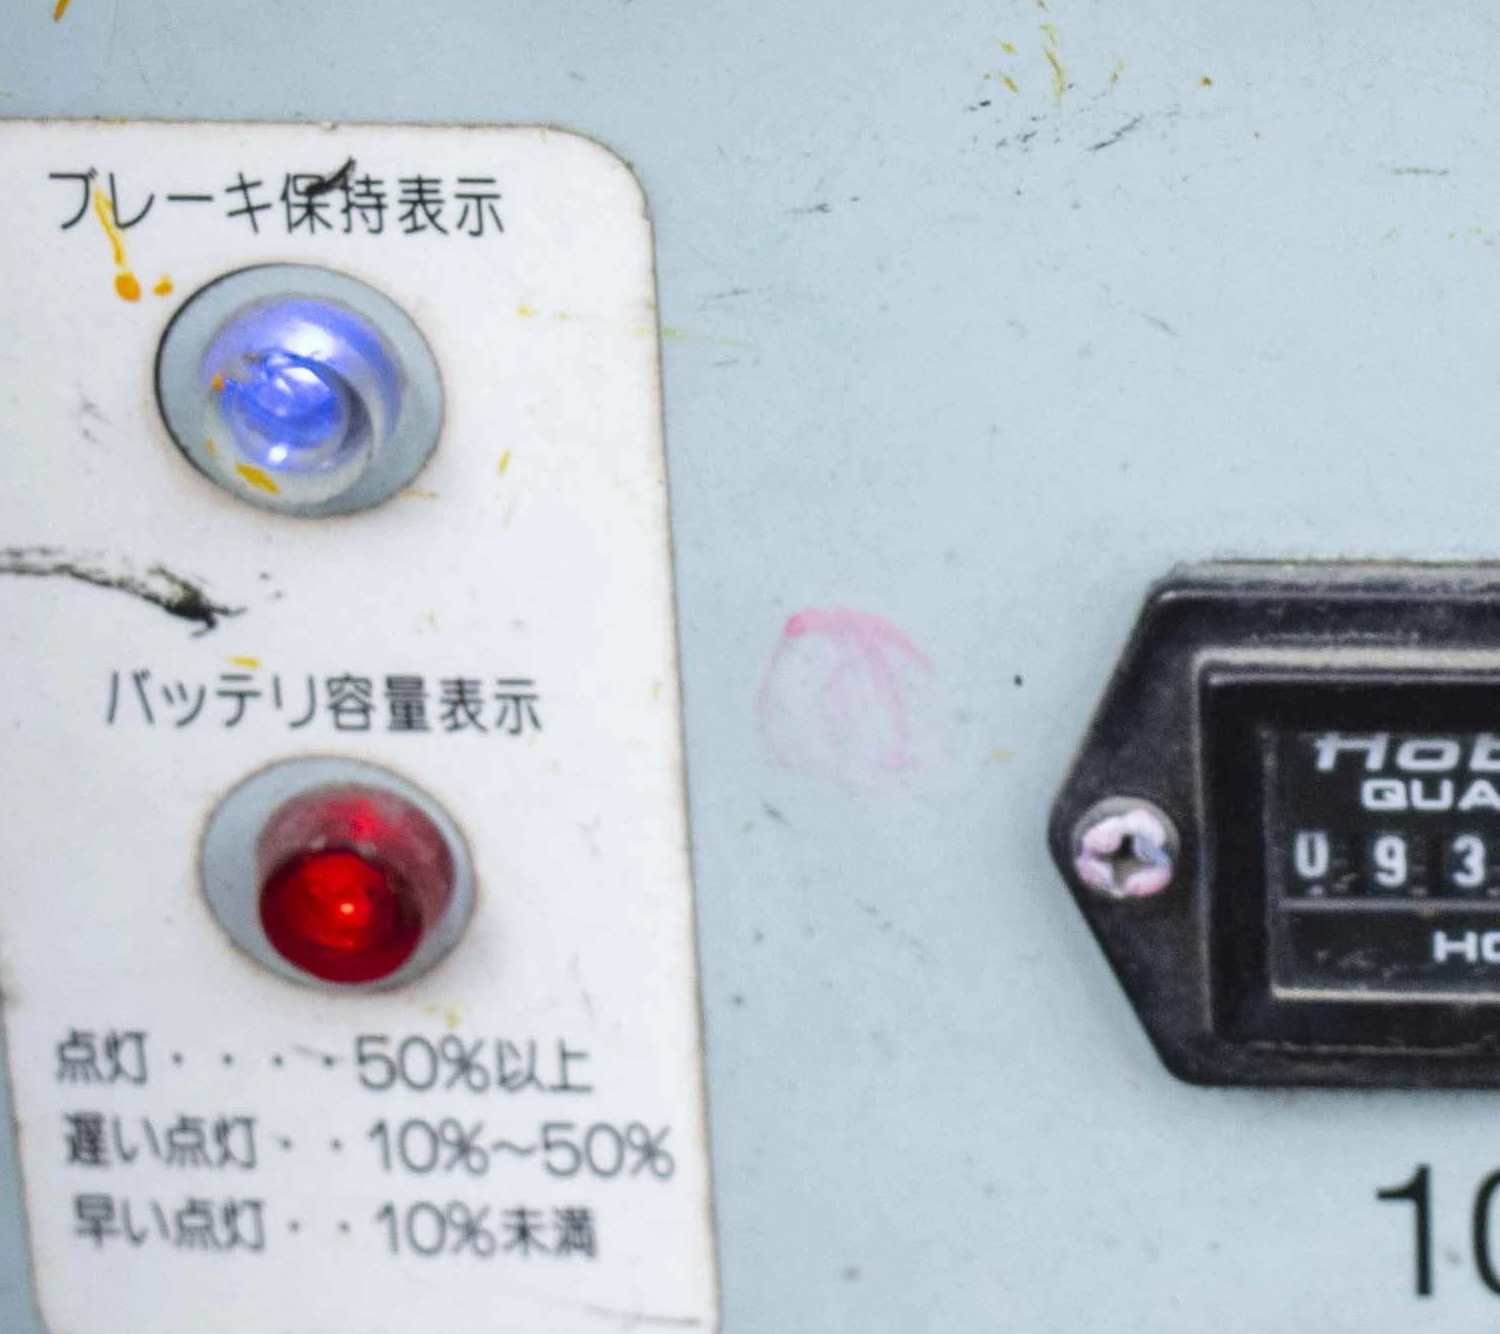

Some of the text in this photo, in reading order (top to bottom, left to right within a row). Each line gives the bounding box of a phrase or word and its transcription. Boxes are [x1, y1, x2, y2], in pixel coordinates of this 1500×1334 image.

[48, 167, 505, 237] ブレーキ保持表示
[106, 670, 542, 735] バッテリ容量表示
